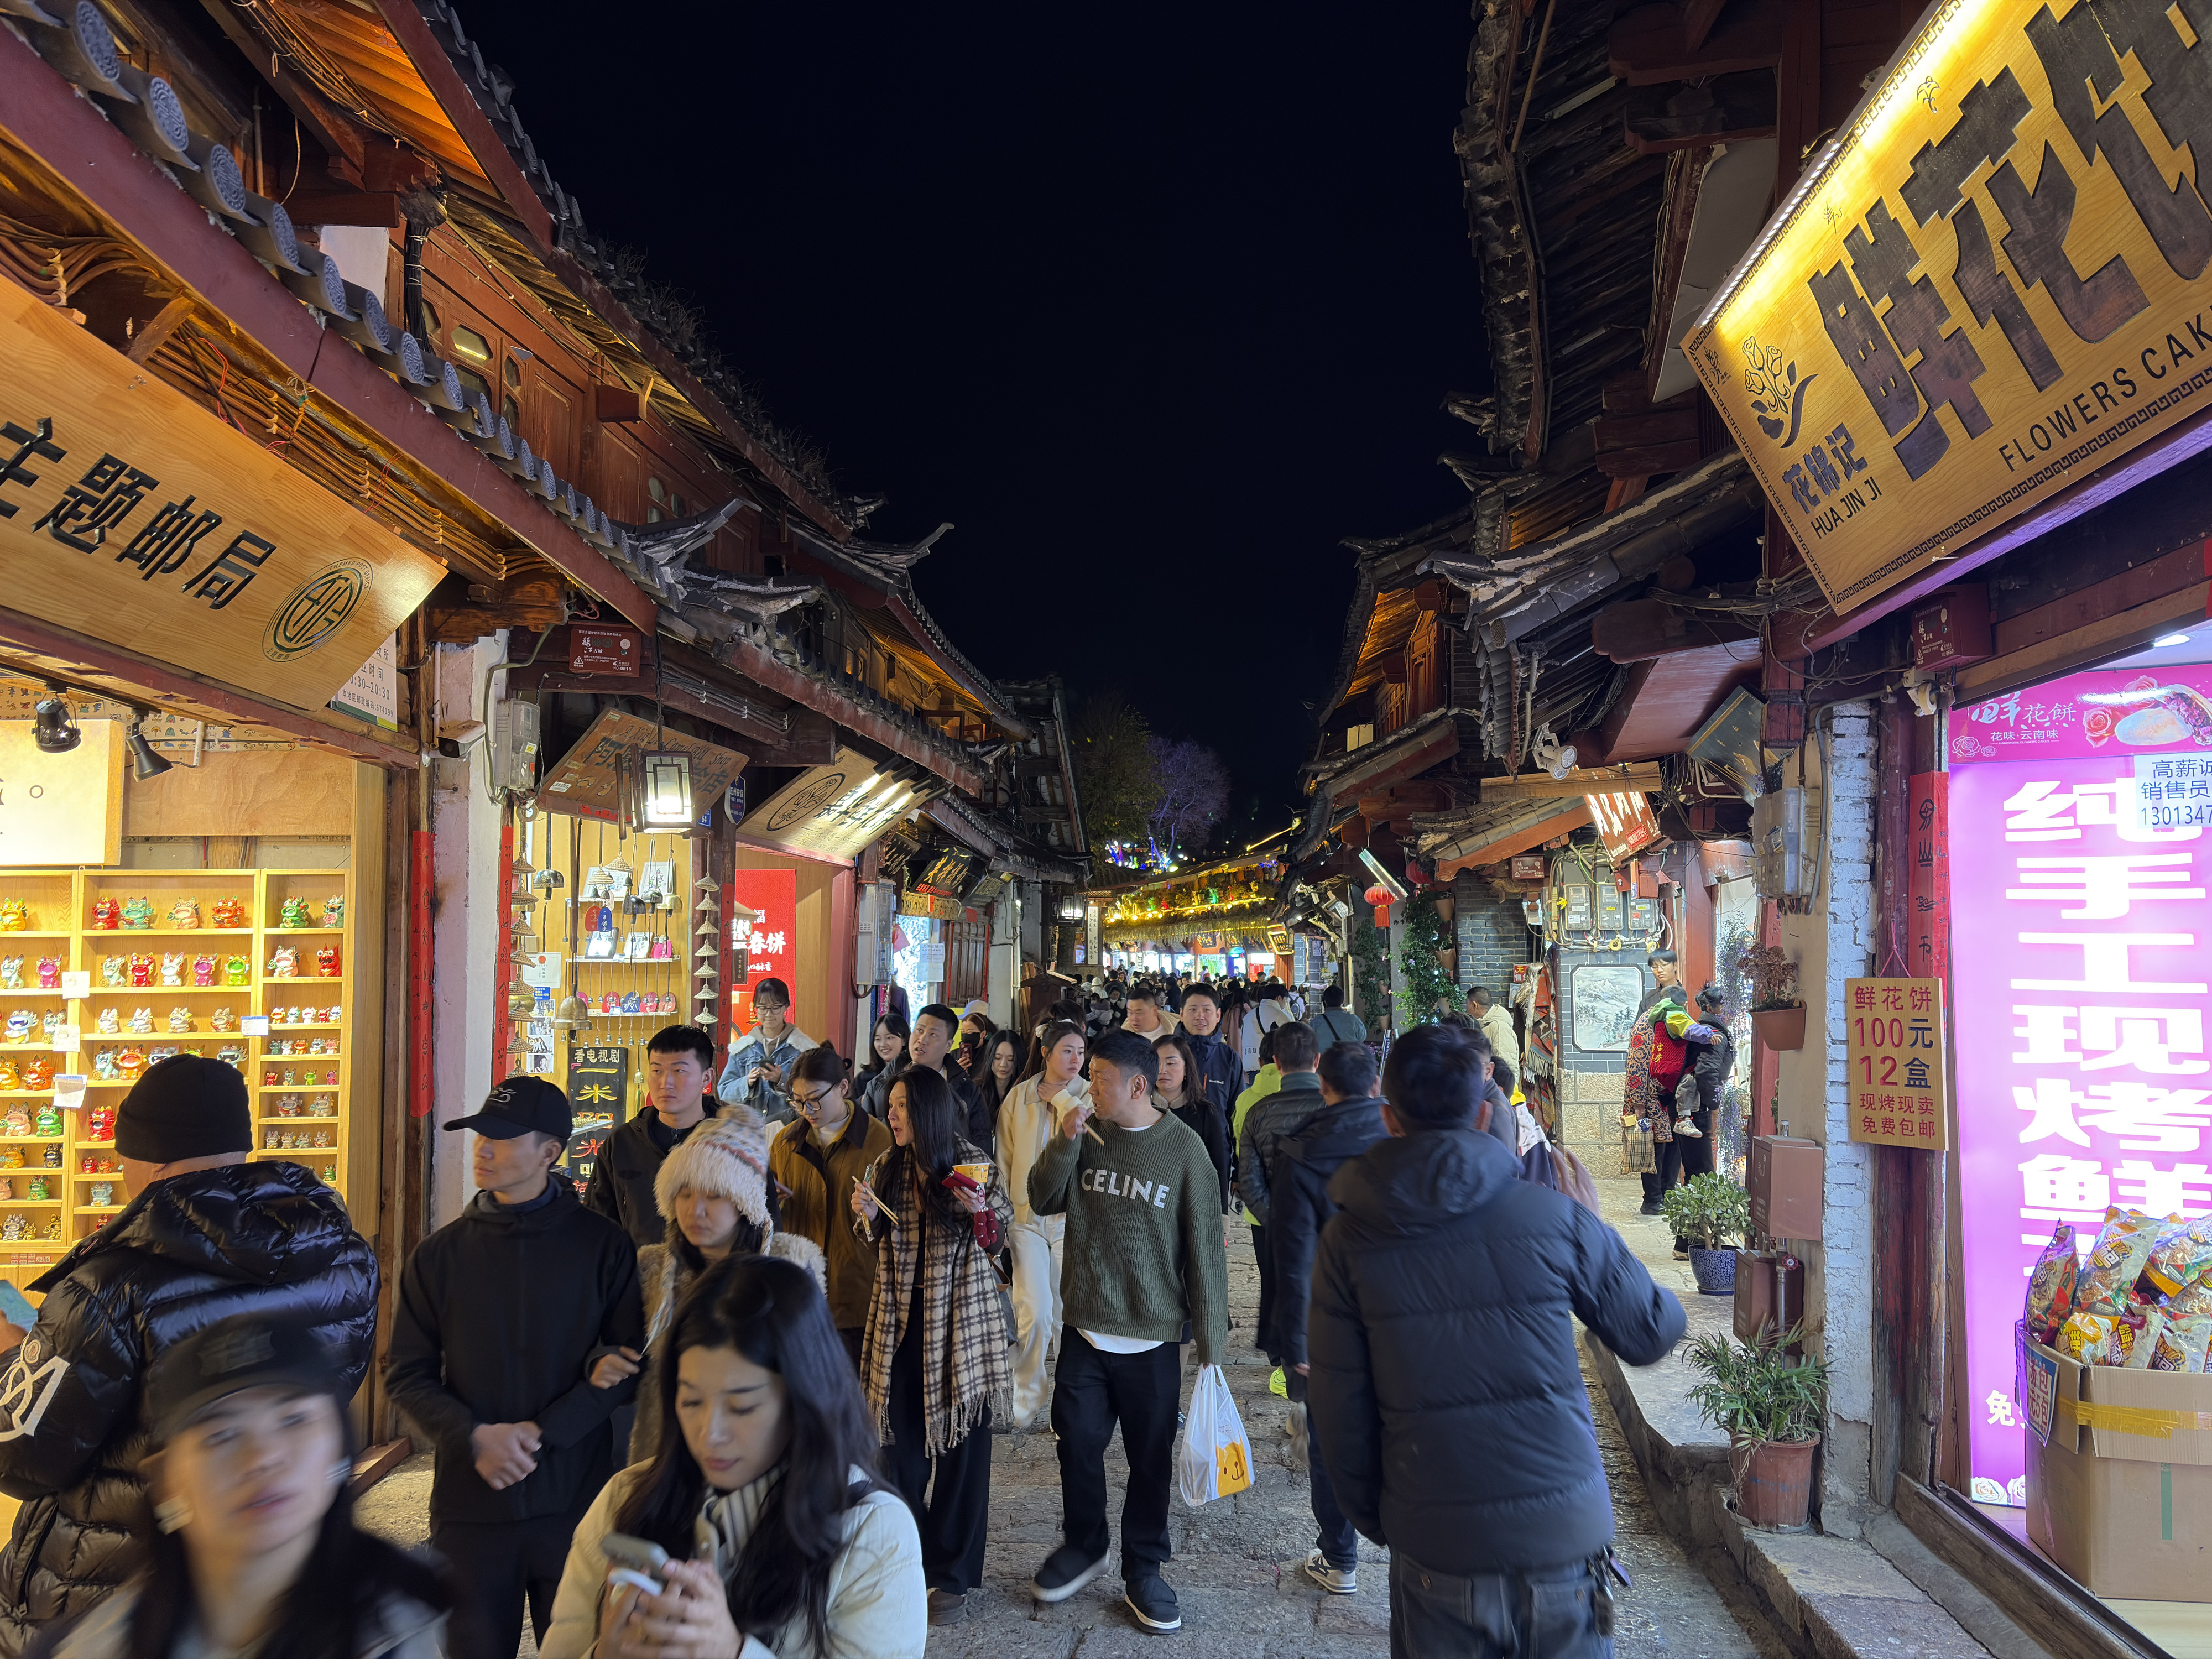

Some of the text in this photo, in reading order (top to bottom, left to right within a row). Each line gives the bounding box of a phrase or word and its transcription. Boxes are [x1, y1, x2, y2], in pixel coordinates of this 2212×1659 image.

[1998, 305, 2212, 472] FLOWERS CAK
[1782, 422, 1869, 514] 花锦记
[1811, 476, 1882, 539] HUA JIN JI
[329, 560, 356, 570] THEMED
[356, 561, 367, 571] POST
[1990, 729, 2059, 742] 花味·云南味
[2141, 780, 2210, 800] 销售员
[1854, 986, 1932, 1012] 鲜花饼
[1854, 1018, 1933, 1048] 100元
[574, 1049, 620, 1063] 看电视剧
[1859, 1055, 1931, 1088] 12盒
[1860, 1093, 1934, 1115] 现烤现卖
[1862, 1115, 1935, 1139] 免费包邮
[1081, 1168, 1170, 1208] CELINE
